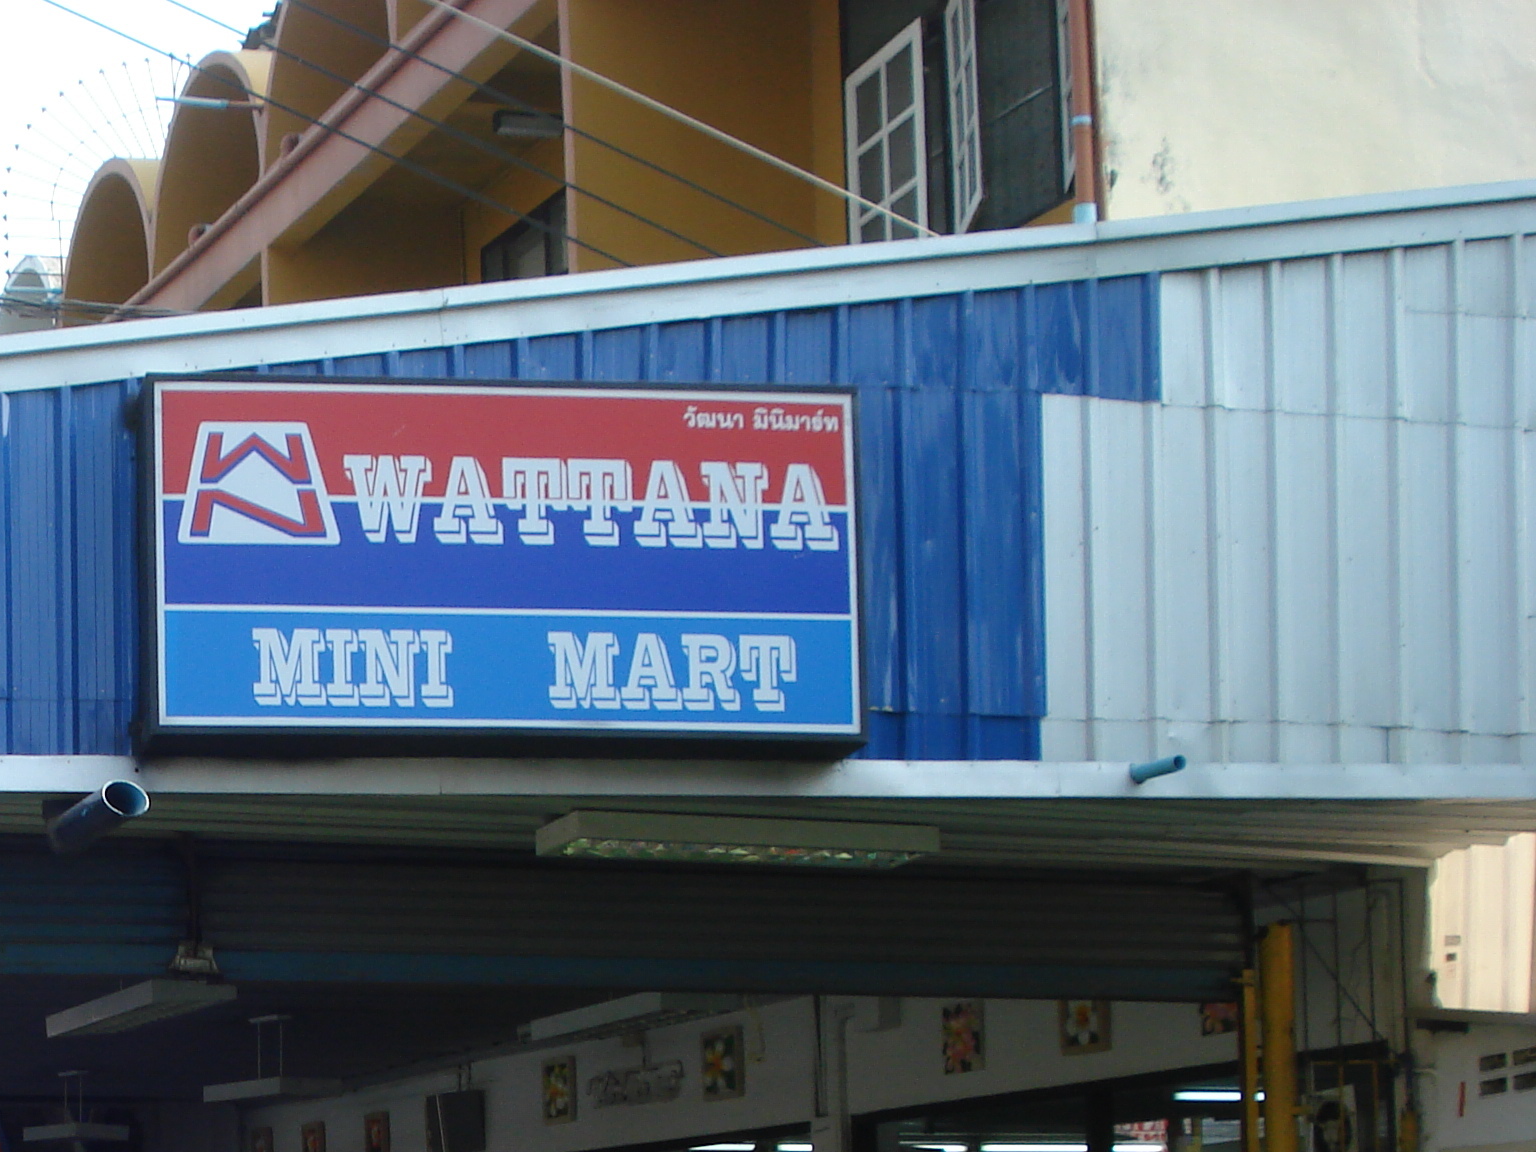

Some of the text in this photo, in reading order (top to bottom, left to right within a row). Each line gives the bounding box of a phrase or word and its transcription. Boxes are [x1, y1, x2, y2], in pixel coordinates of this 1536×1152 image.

[343, 454, 840, 552] WATTANA
[251, 628, 797, 712] MINI MART
